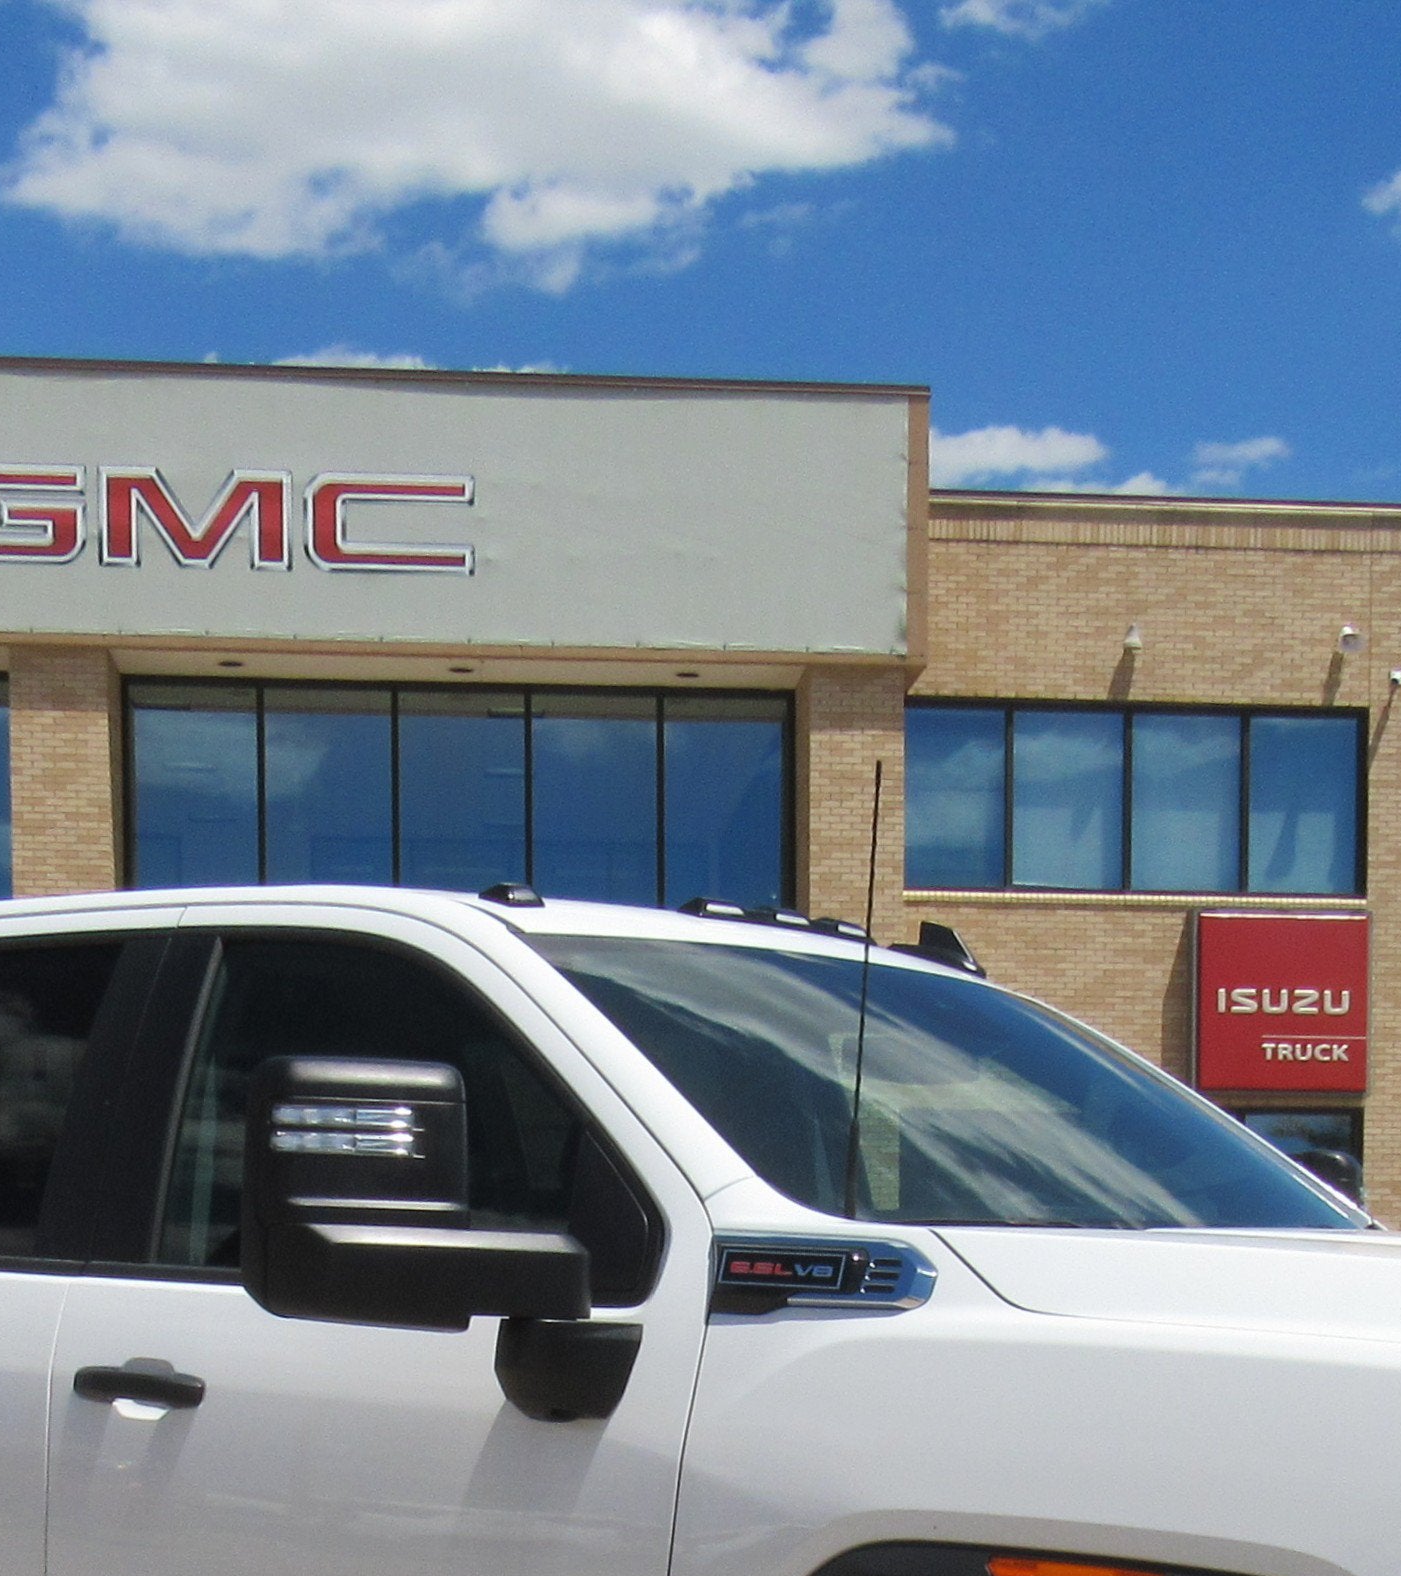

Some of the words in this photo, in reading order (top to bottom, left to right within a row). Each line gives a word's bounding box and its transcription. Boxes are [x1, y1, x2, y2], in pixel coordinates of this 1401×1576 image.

[1217, 987, 1350, 1015] ISUZU
[1261, 1043, 1349, 1062] TRUCK
[793, 1263, 834, 1278] V8
